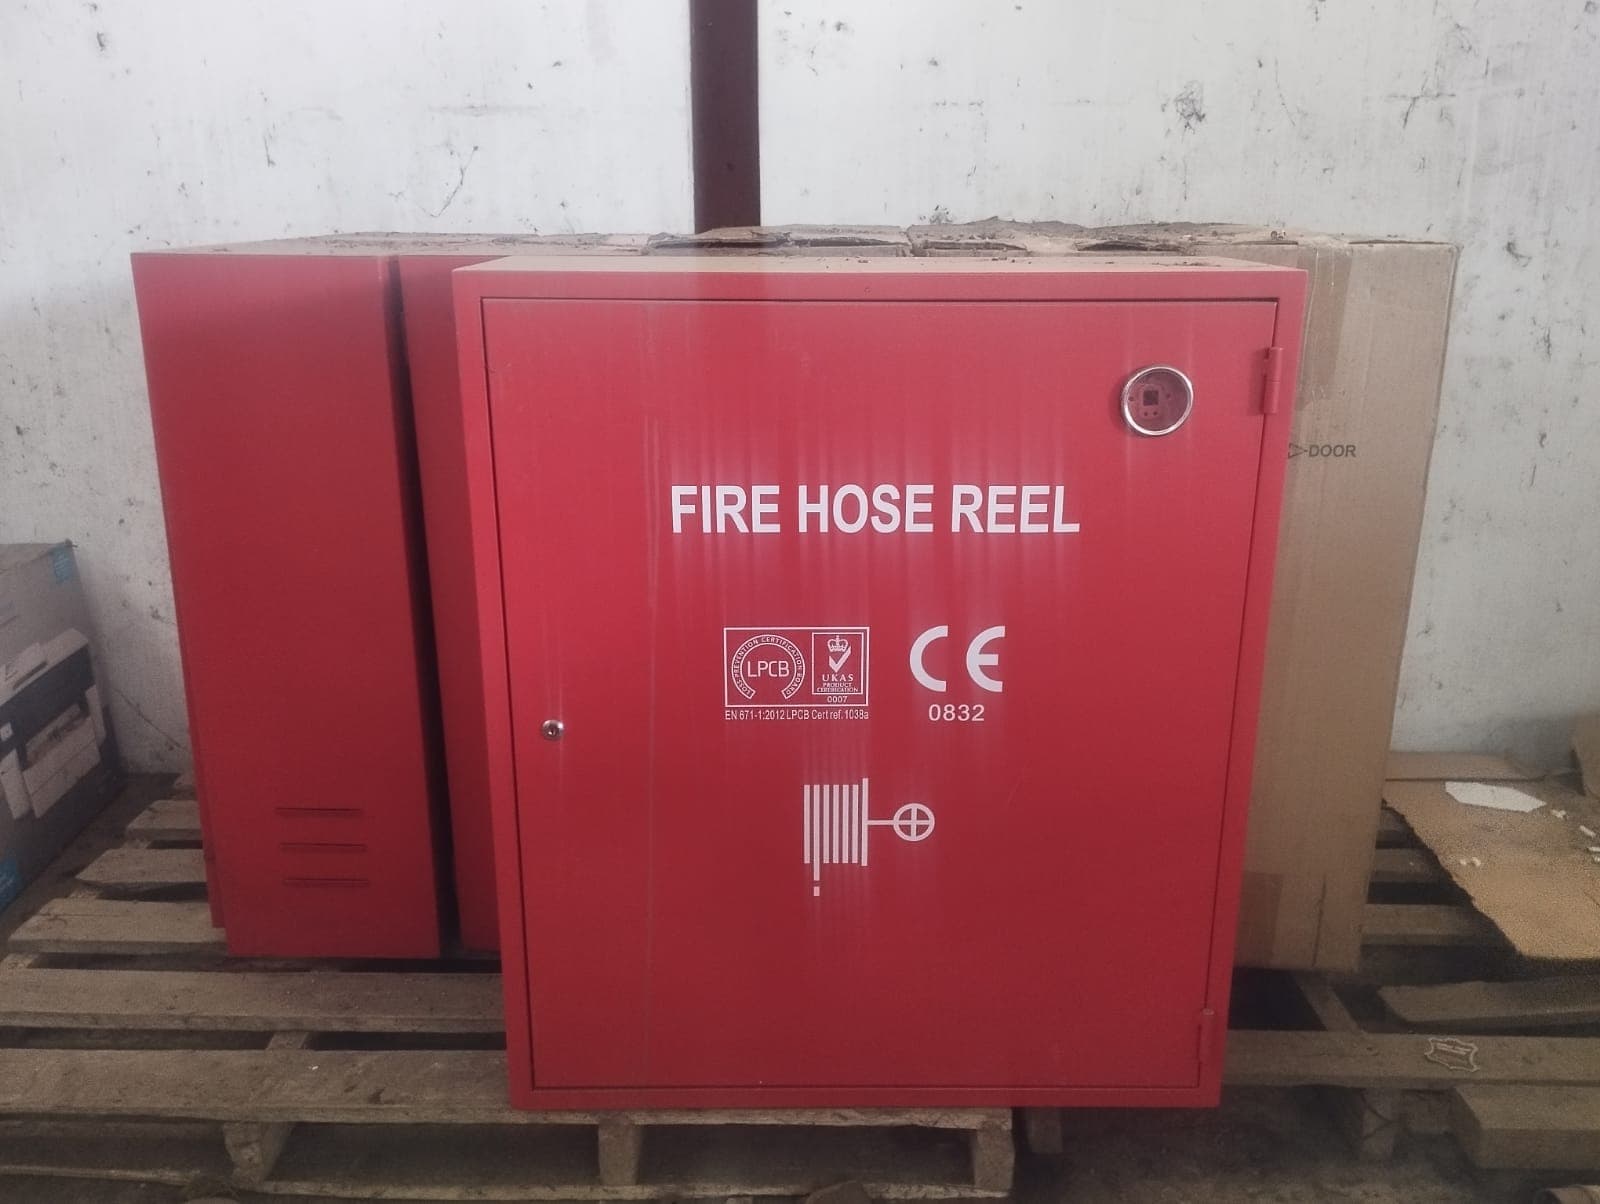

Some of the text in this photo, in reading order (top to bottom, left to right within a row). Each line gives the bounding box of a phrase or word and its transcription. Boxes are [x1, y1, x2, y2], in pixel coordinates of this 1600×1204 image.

[1308, 444, 1357, 458] DOOR
[671, 484, 1080, 534] FIRE HOSE REEL
[747, 660, 790, 677] LPCB
[822, 673, 854, 682] UKAS
[827, 695, 848, 704] 0007
[725, 709, 869, 720] EN 671-1:2012 LPCB Cert ref. 1038a
[928, 704, 985, 722] 0832
